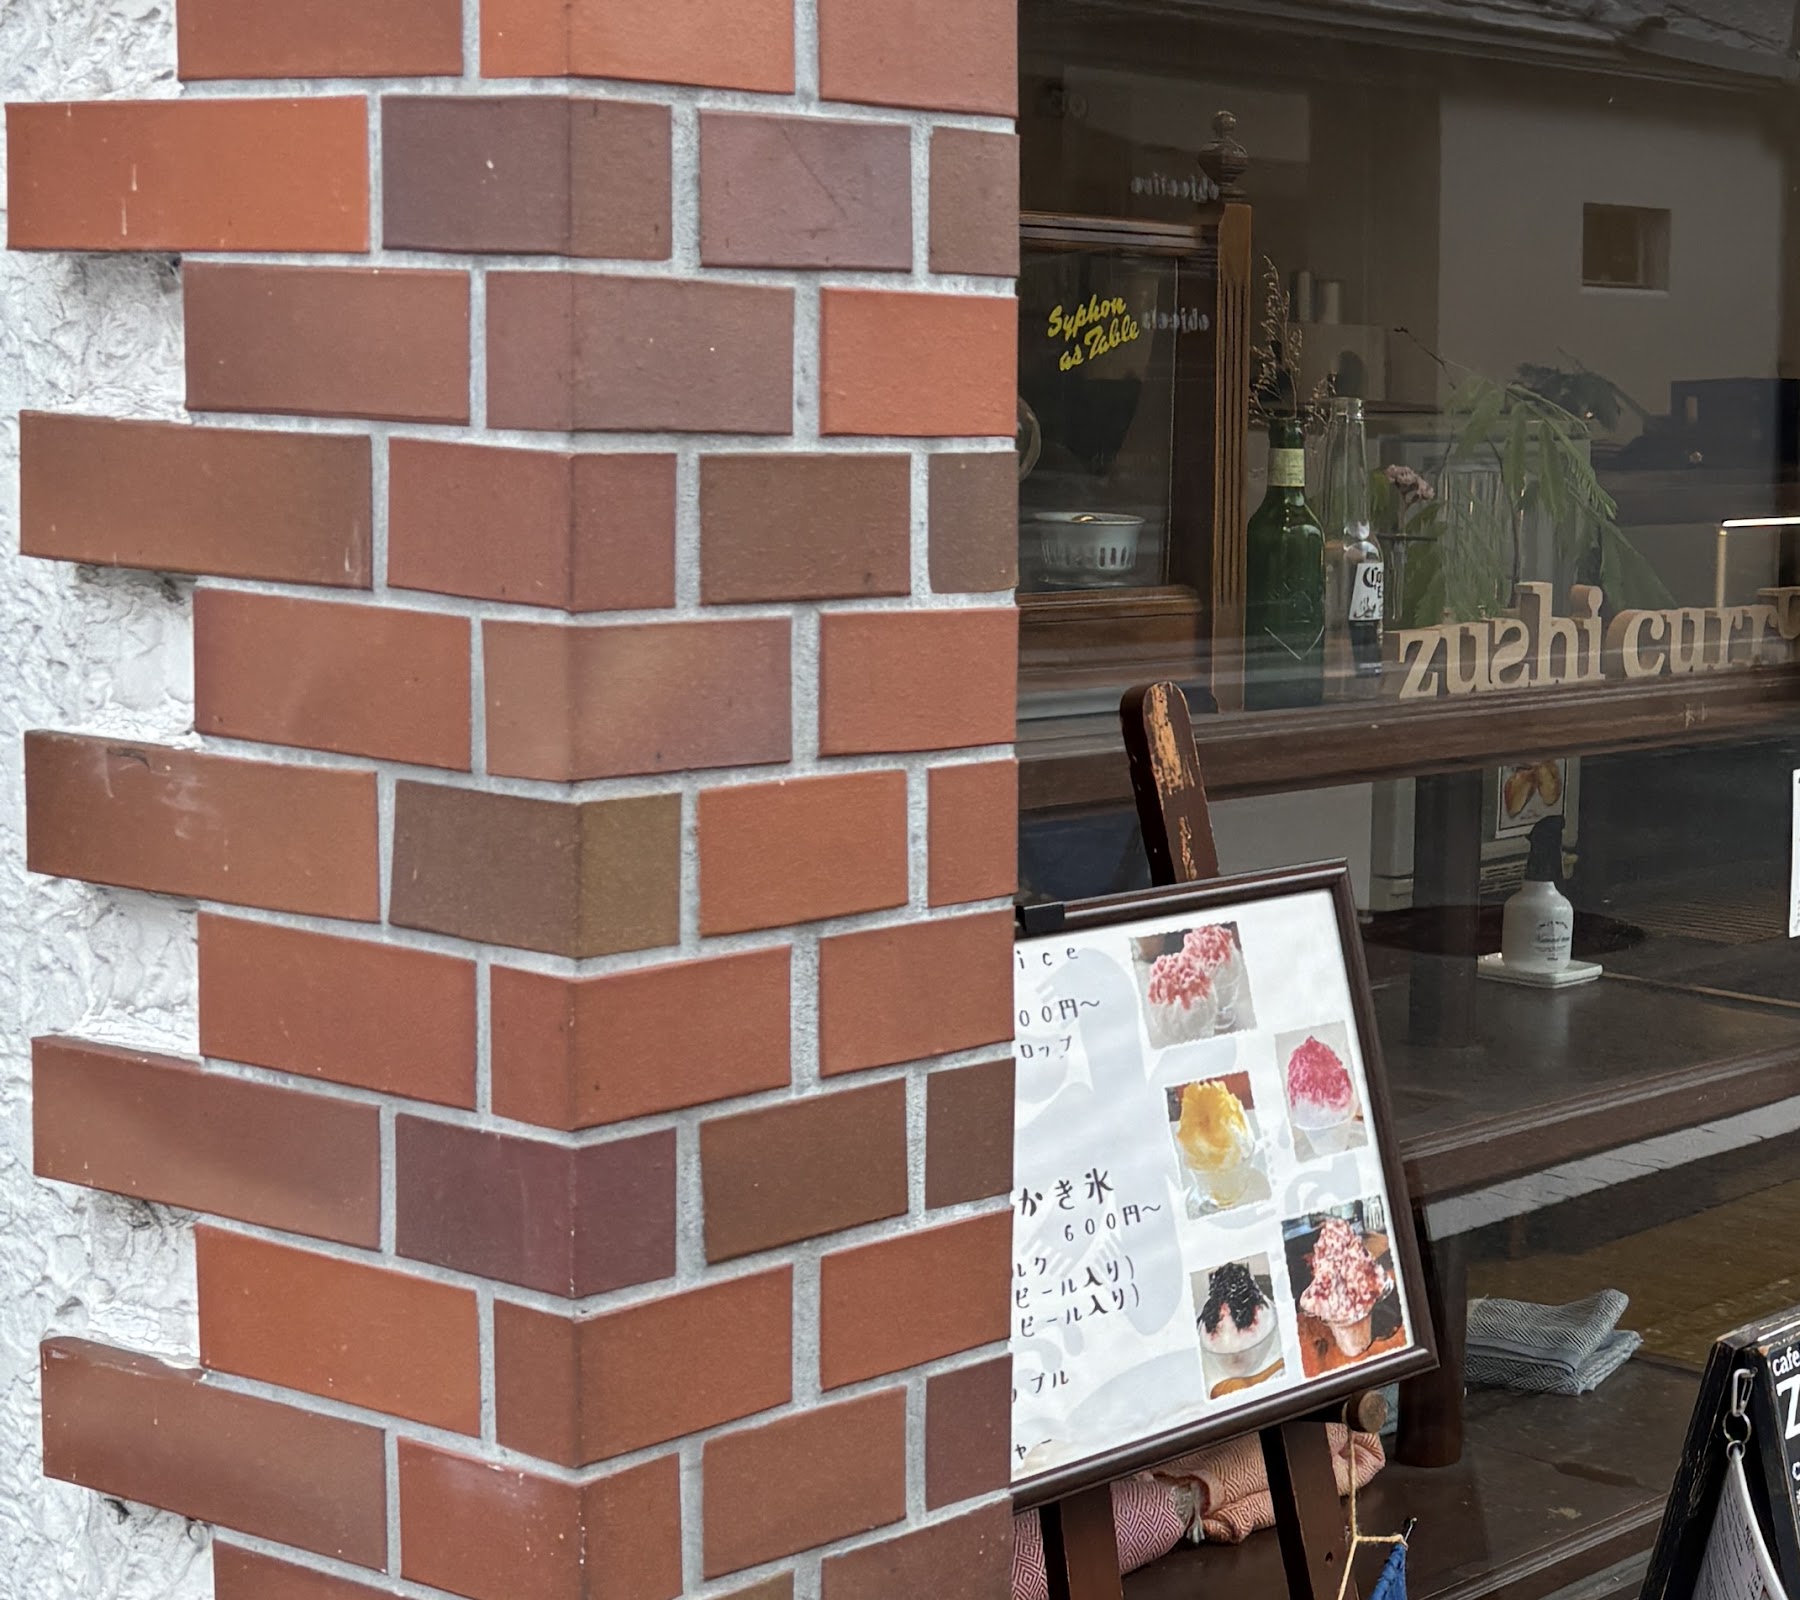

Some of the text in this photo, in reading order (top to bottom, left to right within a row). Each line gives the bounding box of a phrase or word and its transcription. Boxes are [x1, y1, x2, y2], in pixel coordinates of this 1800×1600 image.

[1048, 294, 1126, 341] Syphon
[1059, 344, 1084, 371] as
[1084, 314, 1140, 360] Table
[1398, 581, 1605, 699] zushi
[1018, 1168, 1114, 1217] かき氷
